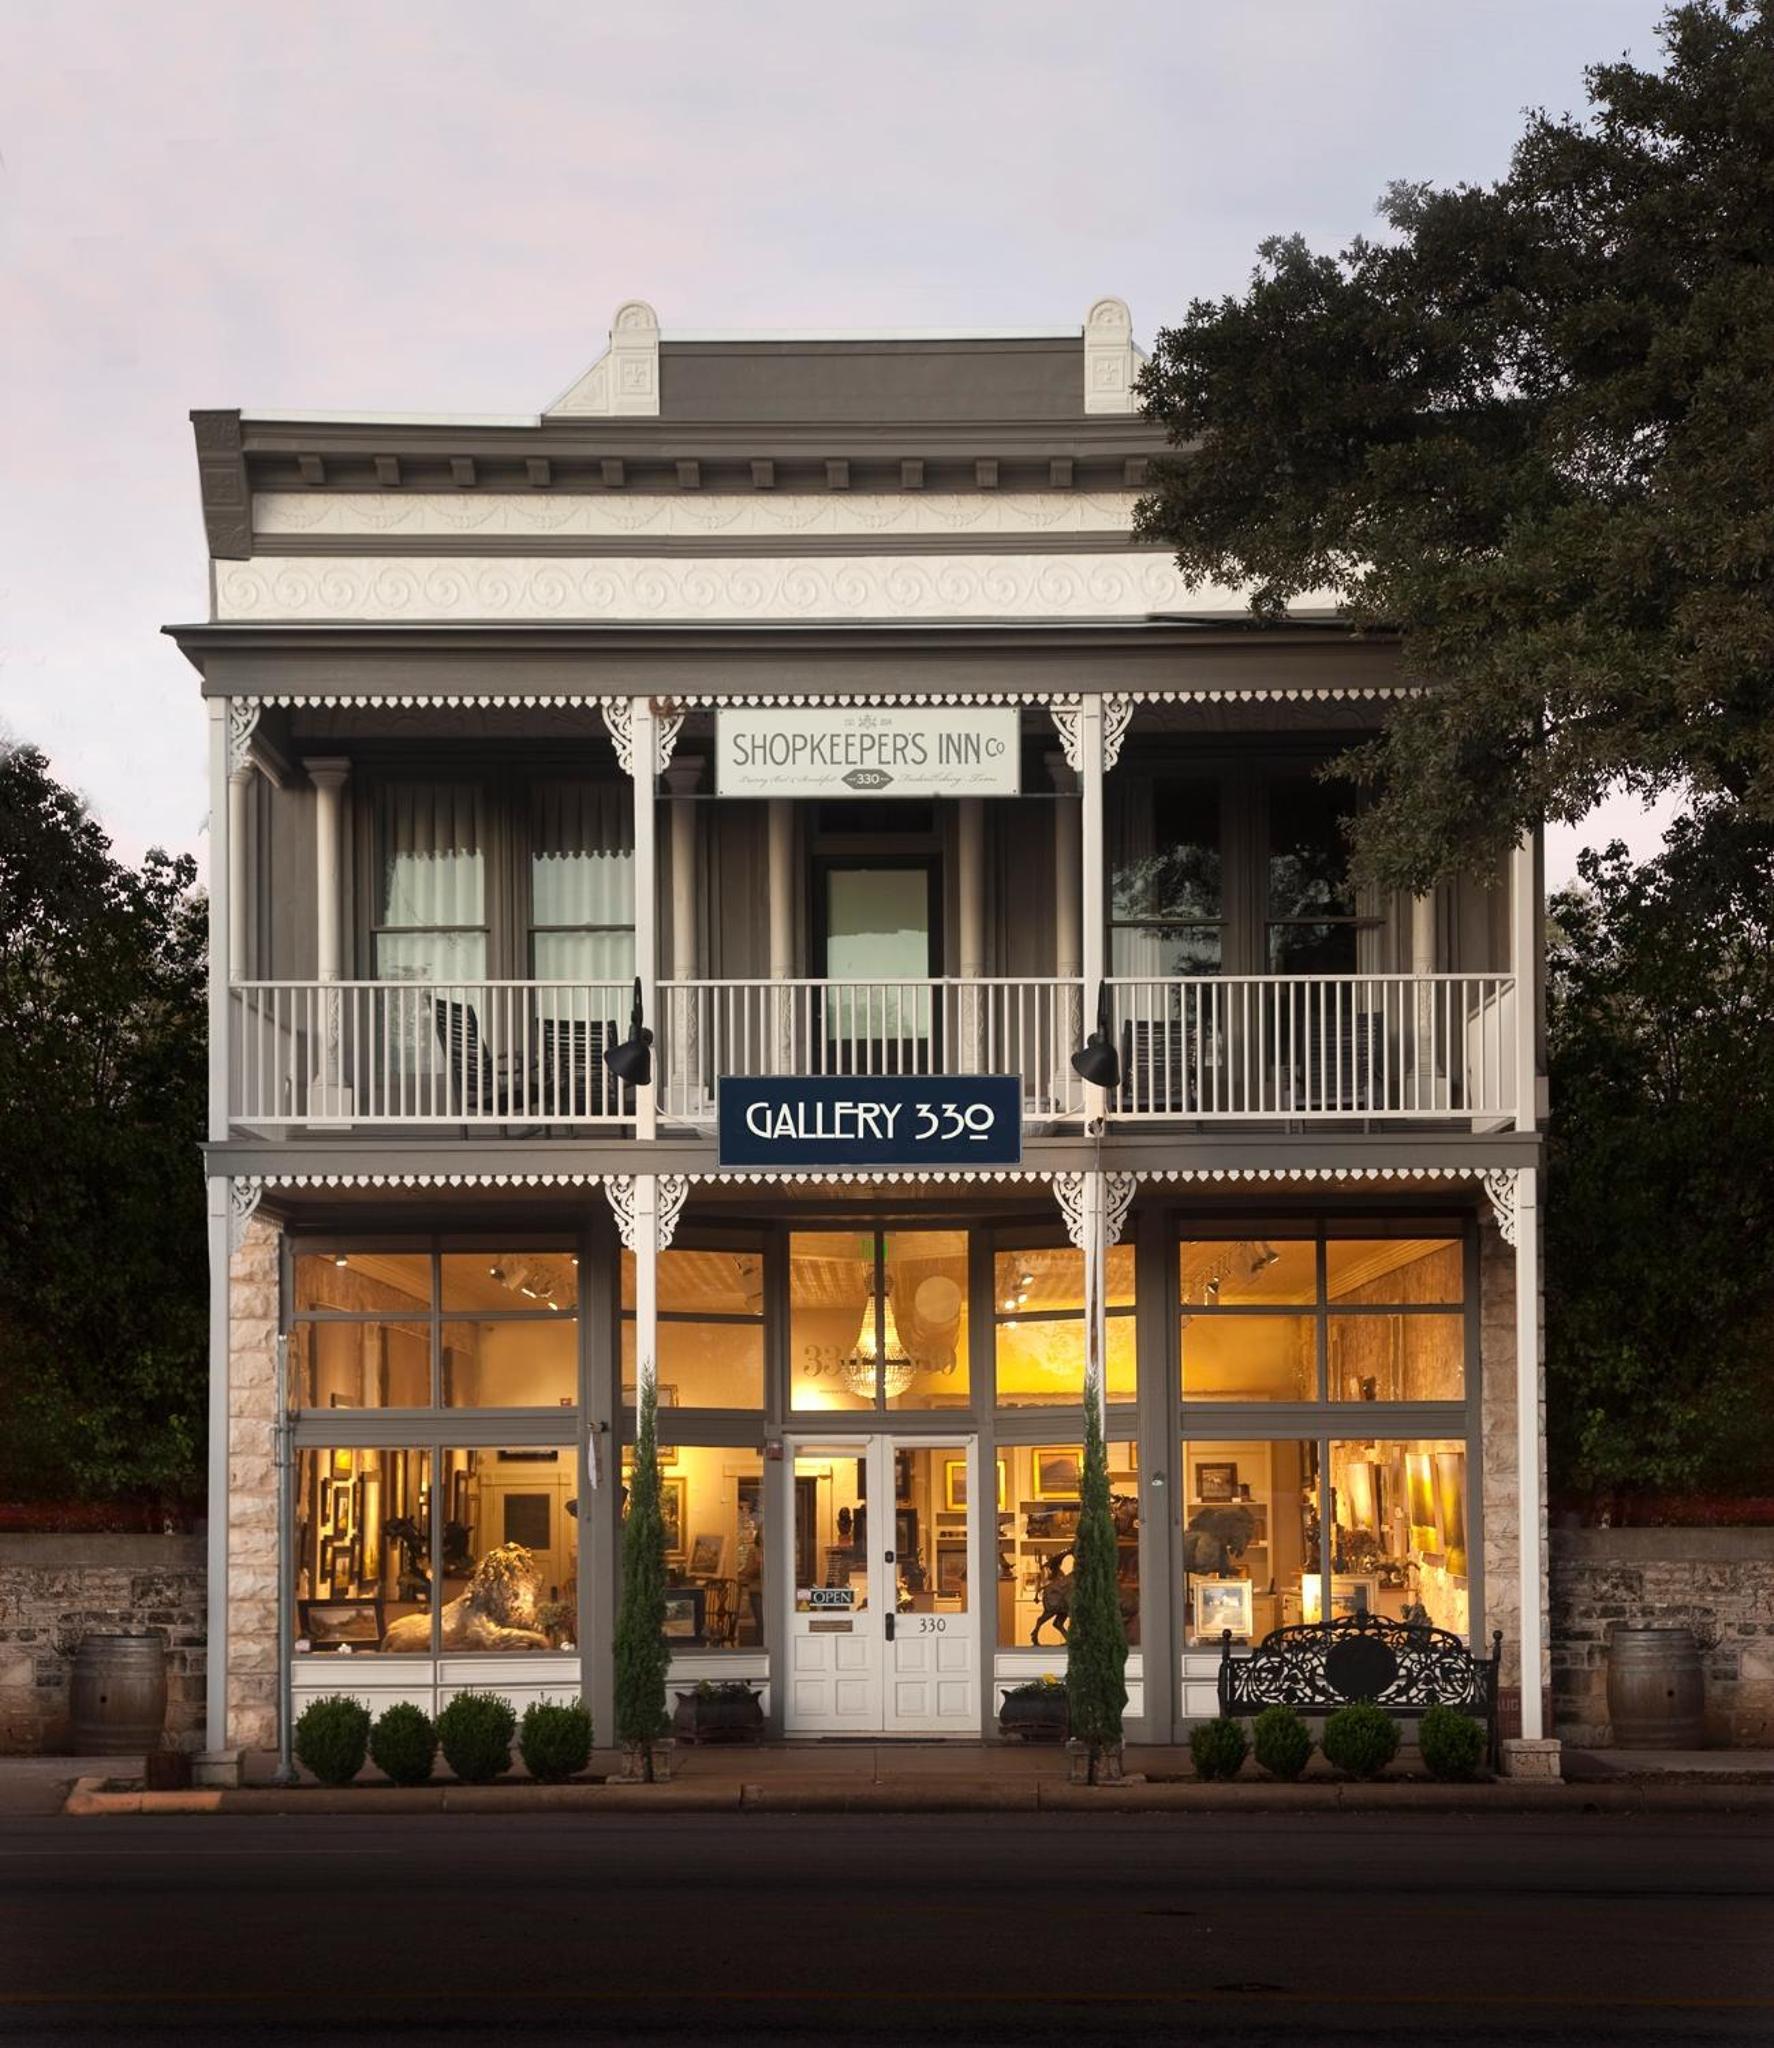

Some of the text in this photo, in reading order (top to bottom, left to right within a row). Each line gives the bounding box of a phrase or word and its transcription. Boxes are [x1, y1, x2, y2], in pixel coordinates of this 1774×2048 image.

[938, 732, 981, 765] INN
[856, 773, 880, 785] 330
[746, 1102, 995, 1140] GALLERY 330
[813, 1591, 852, 1604] OPEN
[919, 1618, 947, 1632] 330
